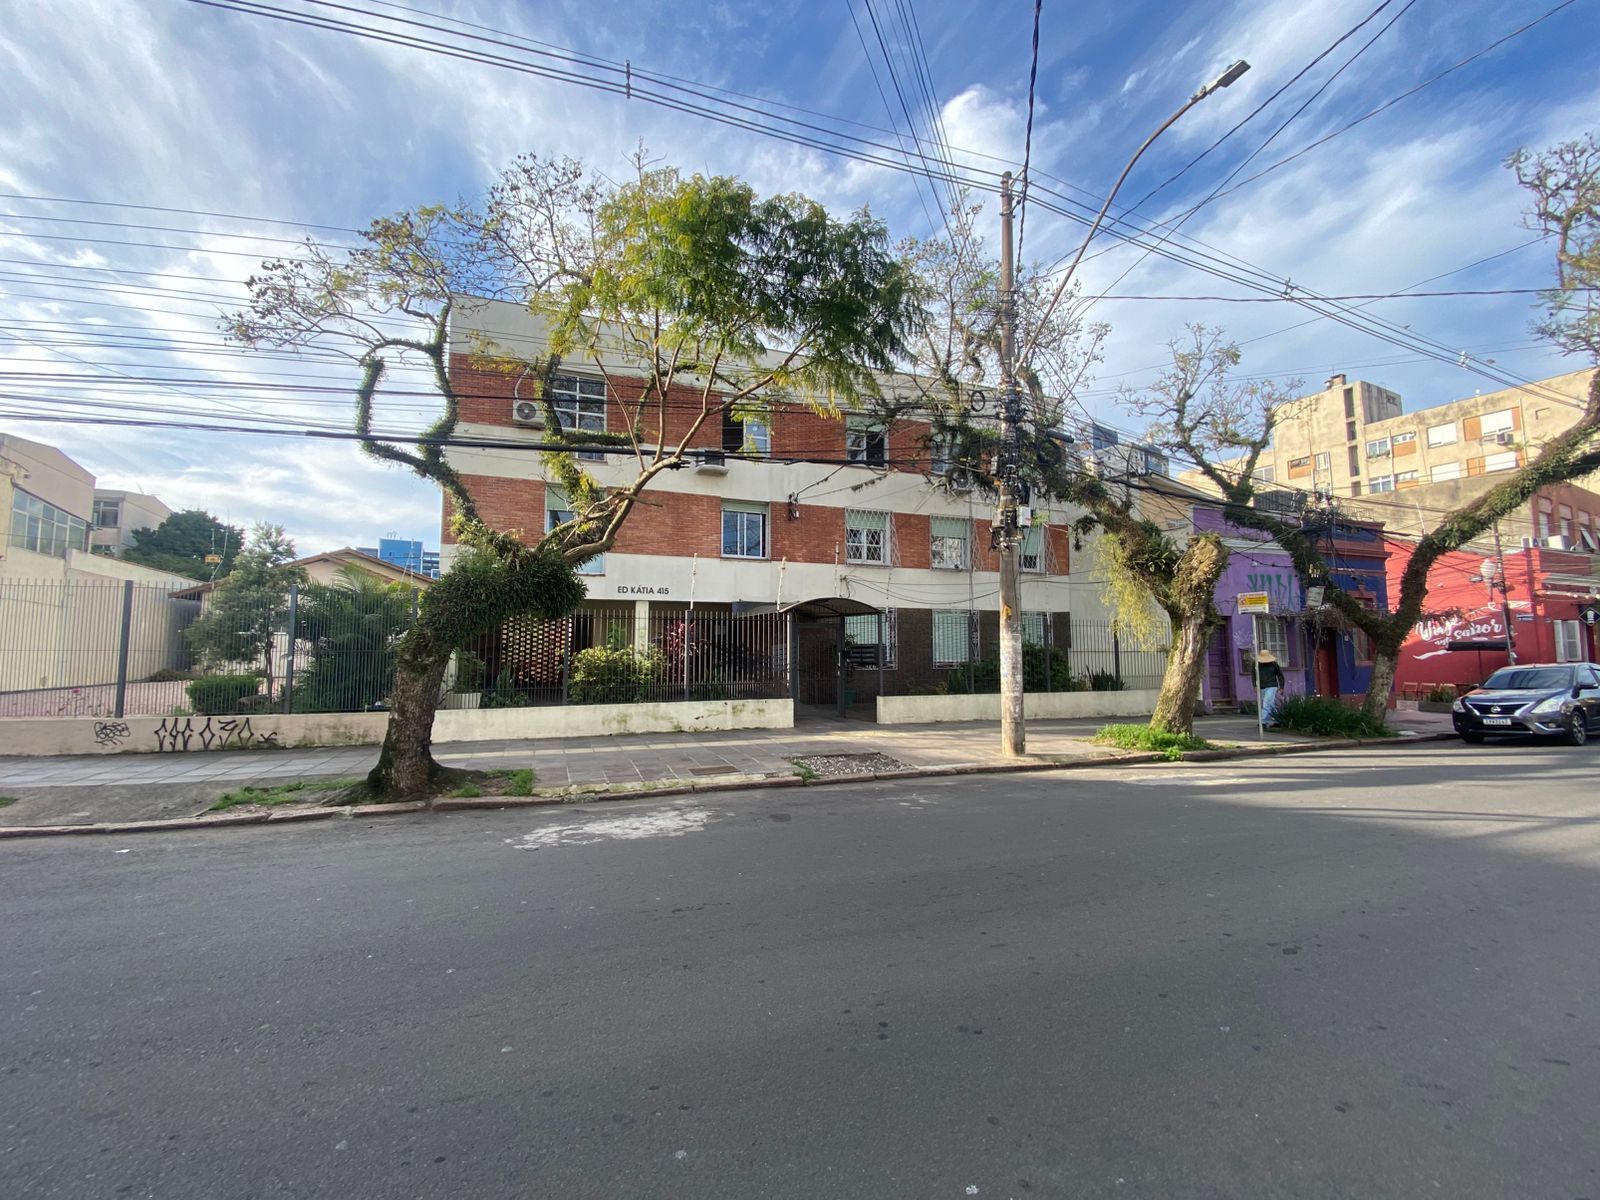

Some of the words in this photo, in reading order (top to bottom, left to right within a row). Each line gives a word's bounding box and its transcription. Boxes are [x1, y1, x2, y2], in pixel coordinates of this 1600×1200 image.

[617, 585, 629, 594] ED
[630, 585, 654, 595] KÁTIA
[657, 587, 670, 595] 415
